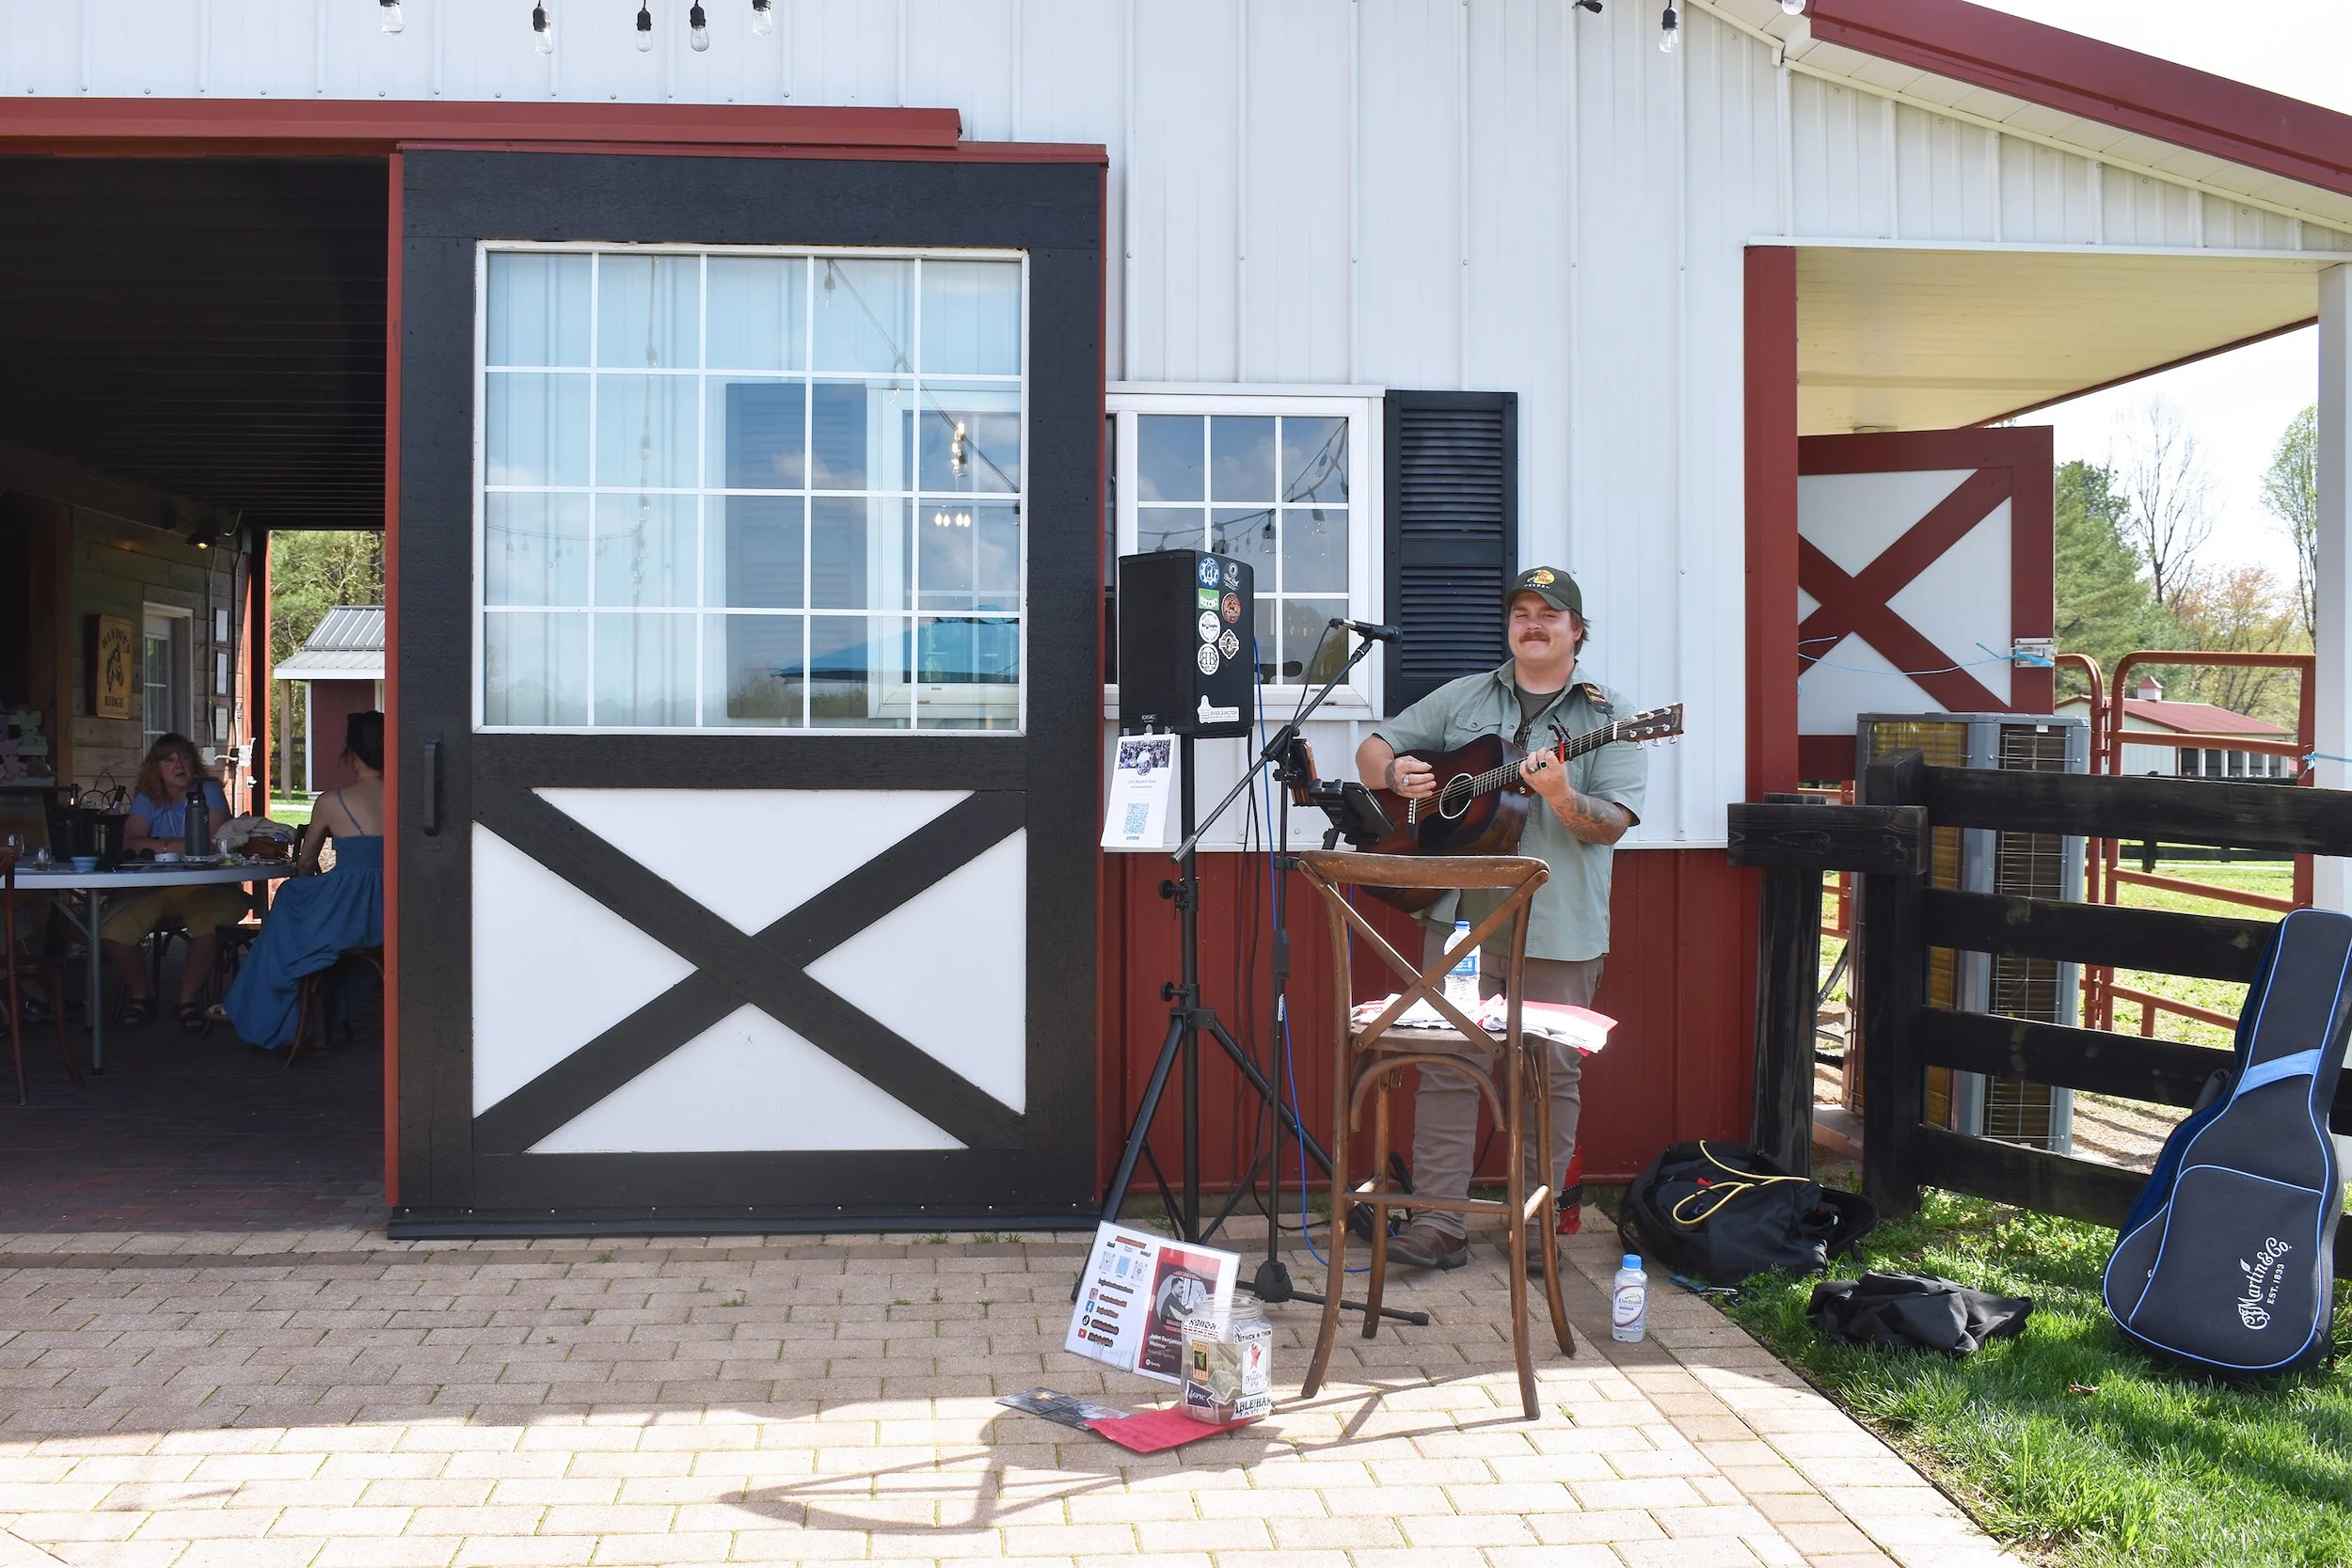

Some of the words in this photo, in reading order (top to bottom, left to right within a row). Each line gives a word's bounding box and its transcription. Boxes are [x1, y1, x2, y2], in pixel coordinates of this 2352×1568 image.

[104, 695, 124, 707] RIDGE
[2272, 1263, 2285, 1285] 1833
[2266, 1285, 2279, 1305] EST.
